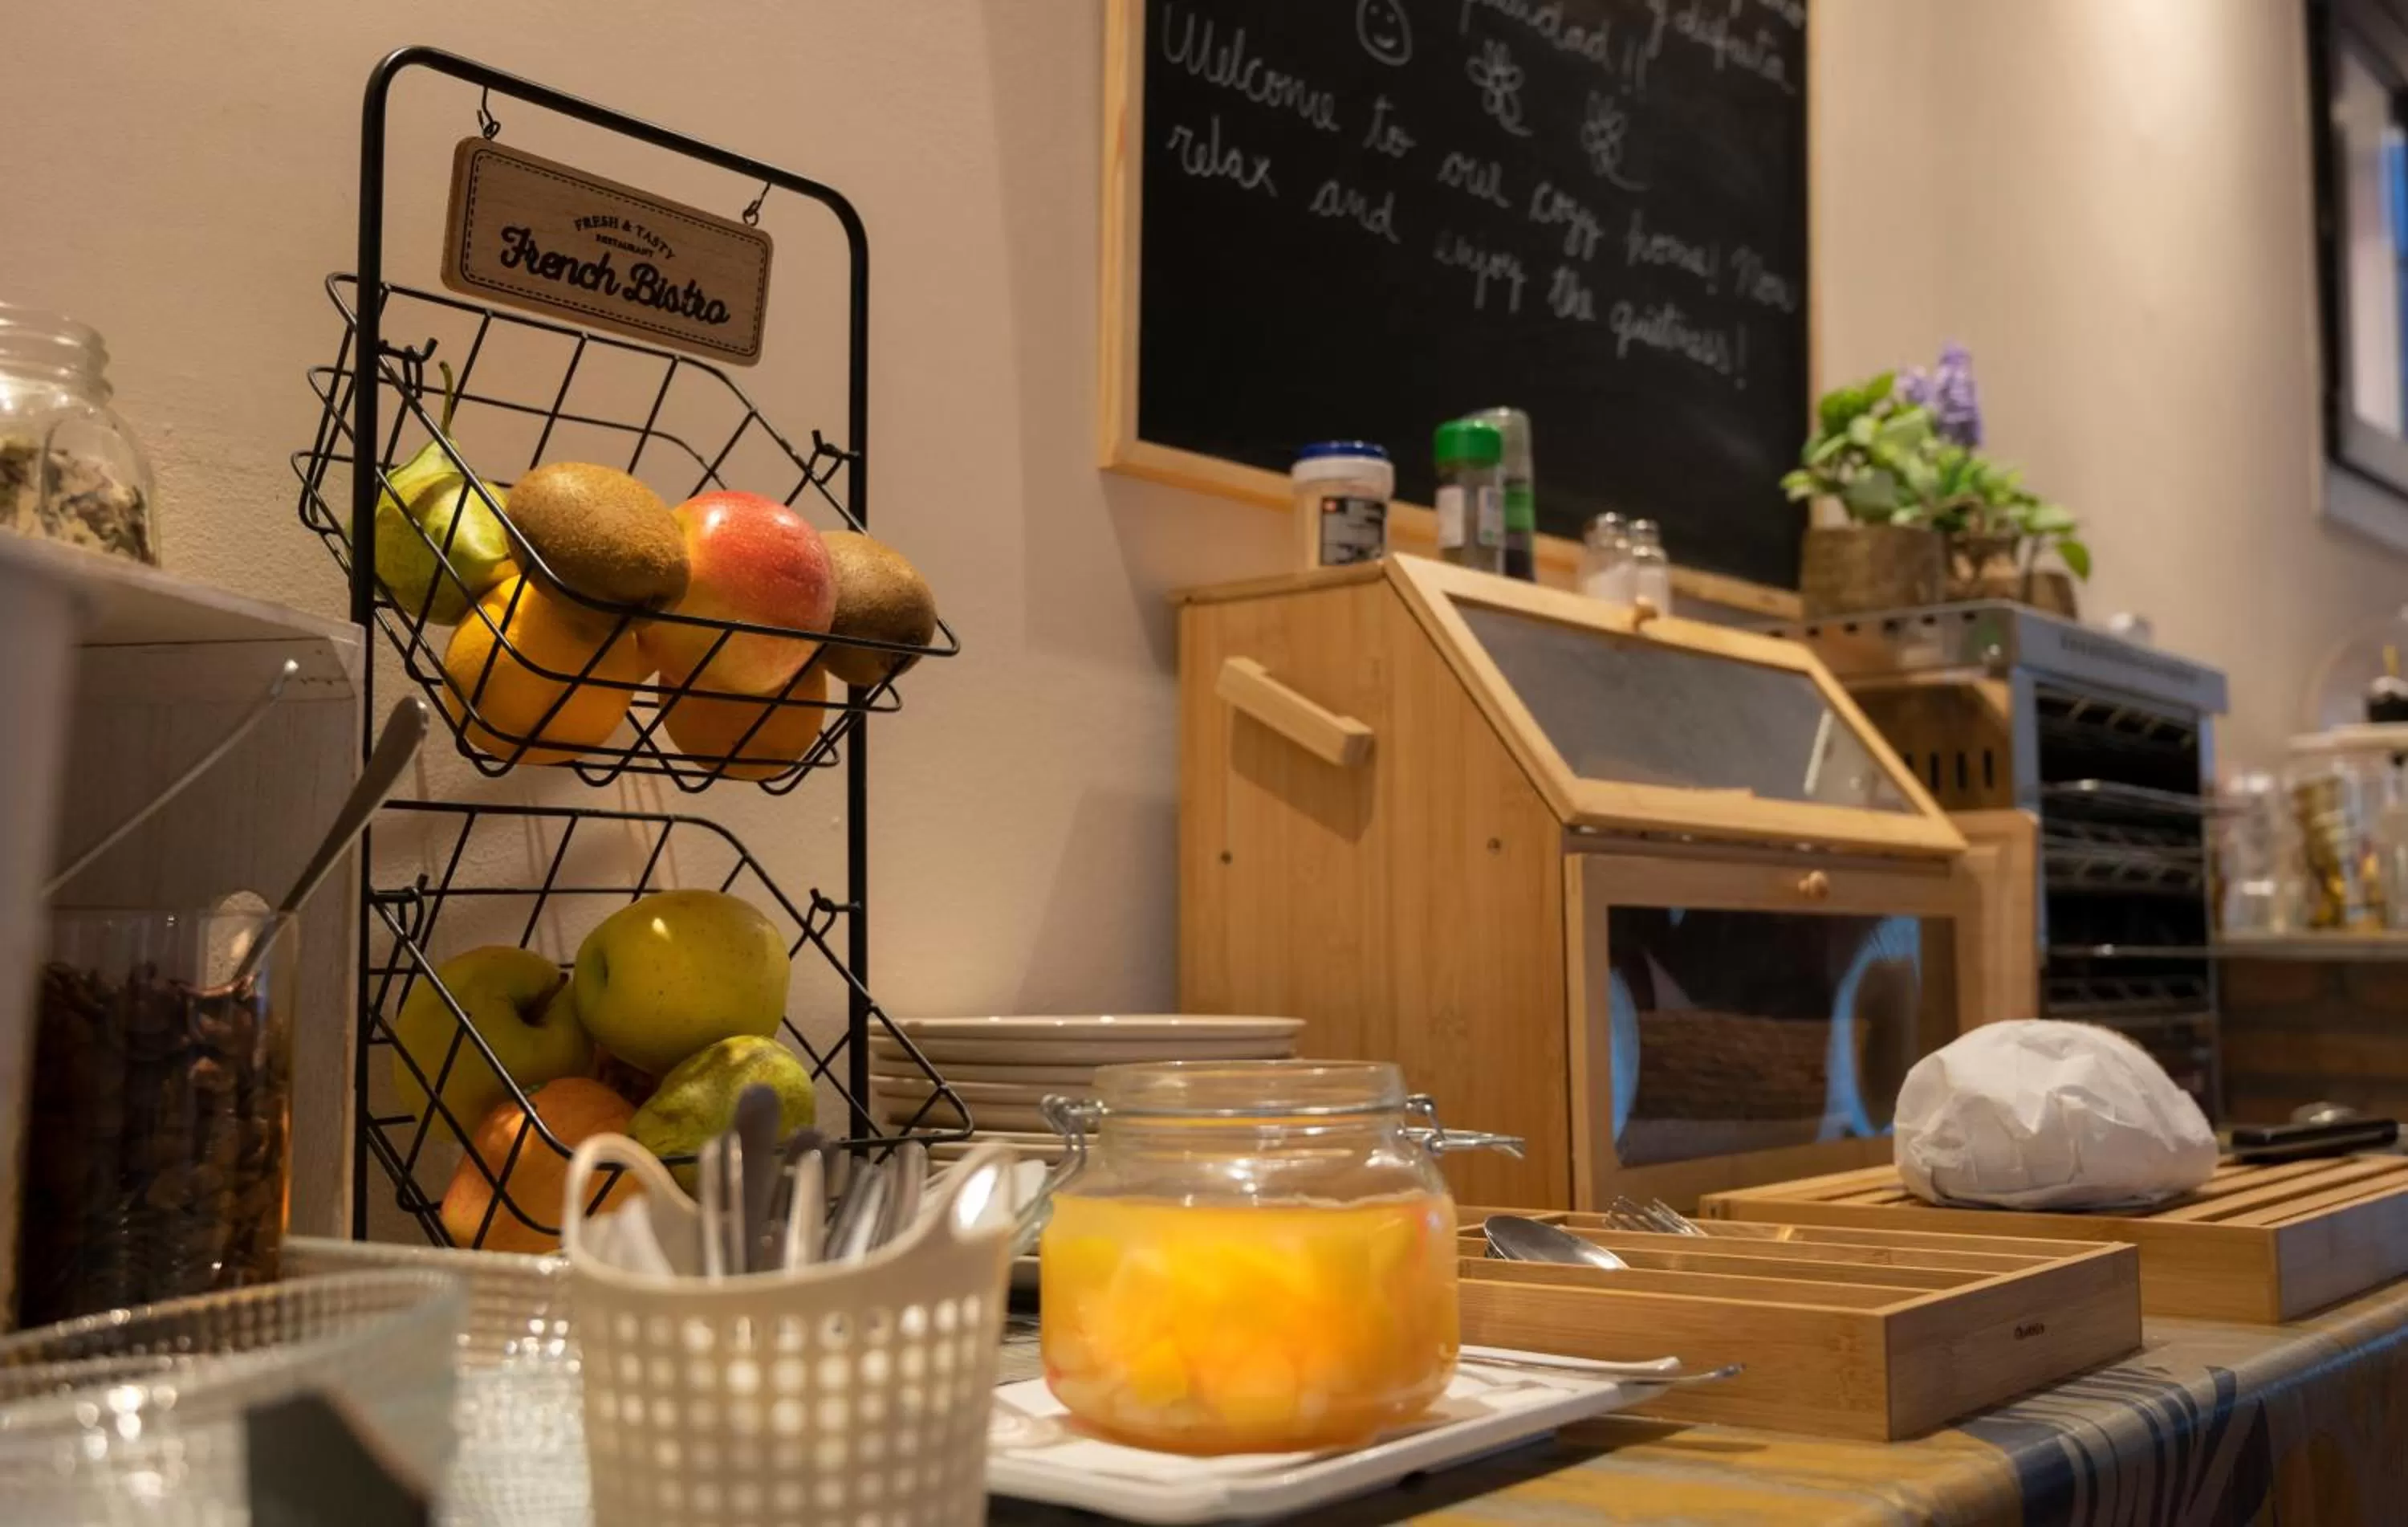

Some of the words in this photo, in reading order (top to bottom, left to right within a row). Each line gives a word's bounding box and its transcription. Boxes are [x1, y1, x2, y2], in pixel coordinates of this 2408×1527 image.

[1162, 2, 1340, 132] Welcome
[1361, 93, 1418, 158] to
[1437, 150, 1511, 208] our
[500, 226, 621, 297] French
[622, 262, 731, 325] Bistro
[574, 215, 620, 232] FRESH
[621, 219, 632, 232] &
[635, 224, 676, 259] TASTY
[1165, 112, 1279, 197] relax
[1308, 178, 1401, 244] and
[1433, 230, 1528, 313] enjoy
[1548, 264, 1596, 320] the
